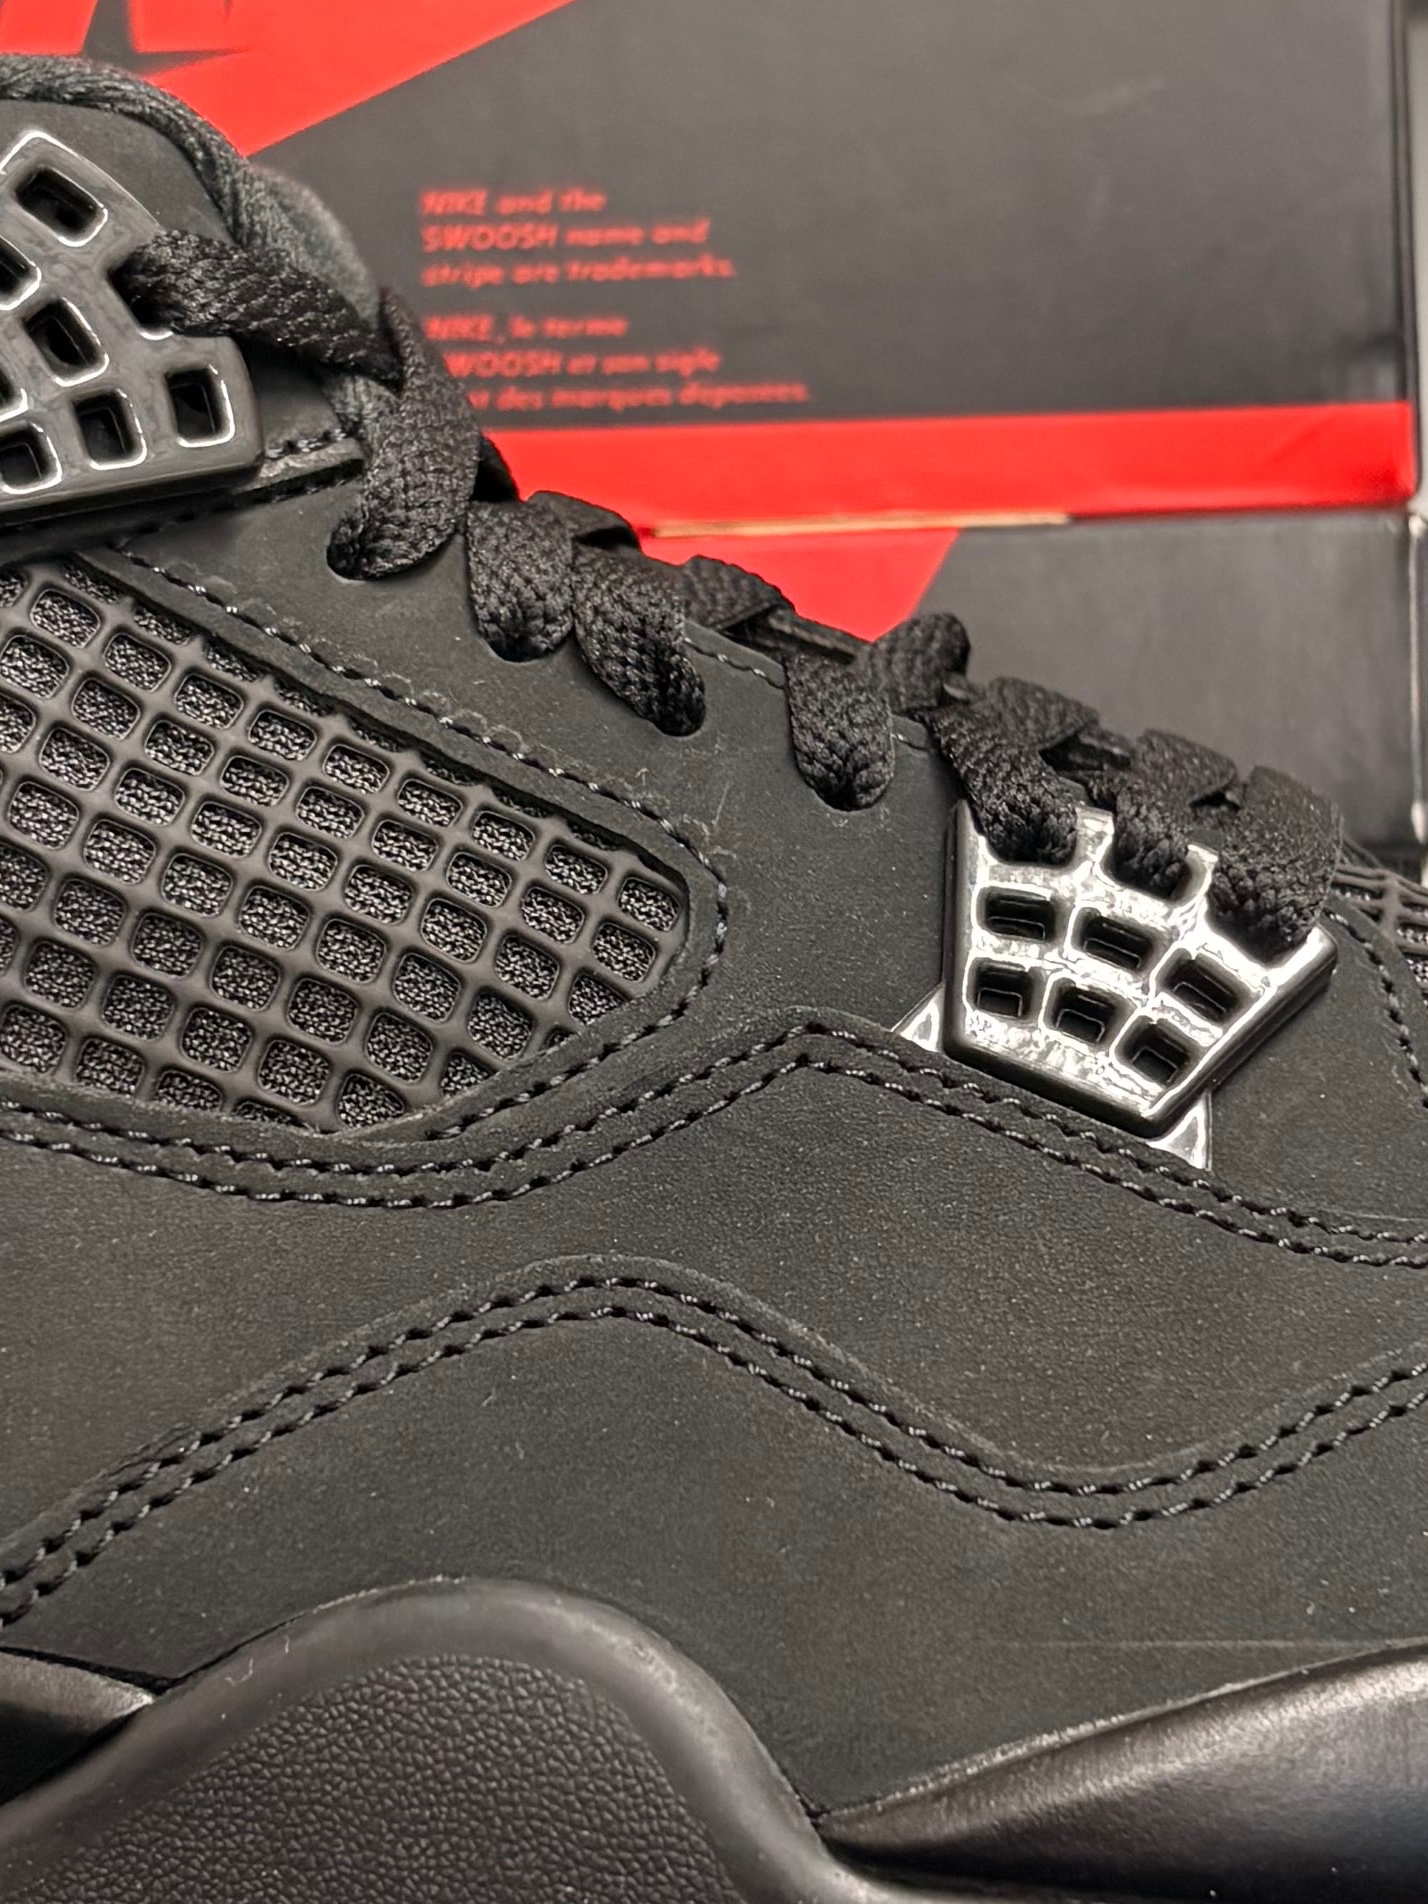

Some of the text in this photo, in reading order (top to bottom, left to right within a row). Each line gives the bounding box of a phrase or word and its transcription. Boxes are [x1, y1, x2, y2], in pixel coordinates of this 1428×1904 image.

[421, 188, 606, 216] NIKE and the
[421, 218, 711, 253] SWOOSH name and
[421, 262, 504, 290] stripe
[511, 263, 560, 284] are
[443, 350, 562, 379] WOOSH
